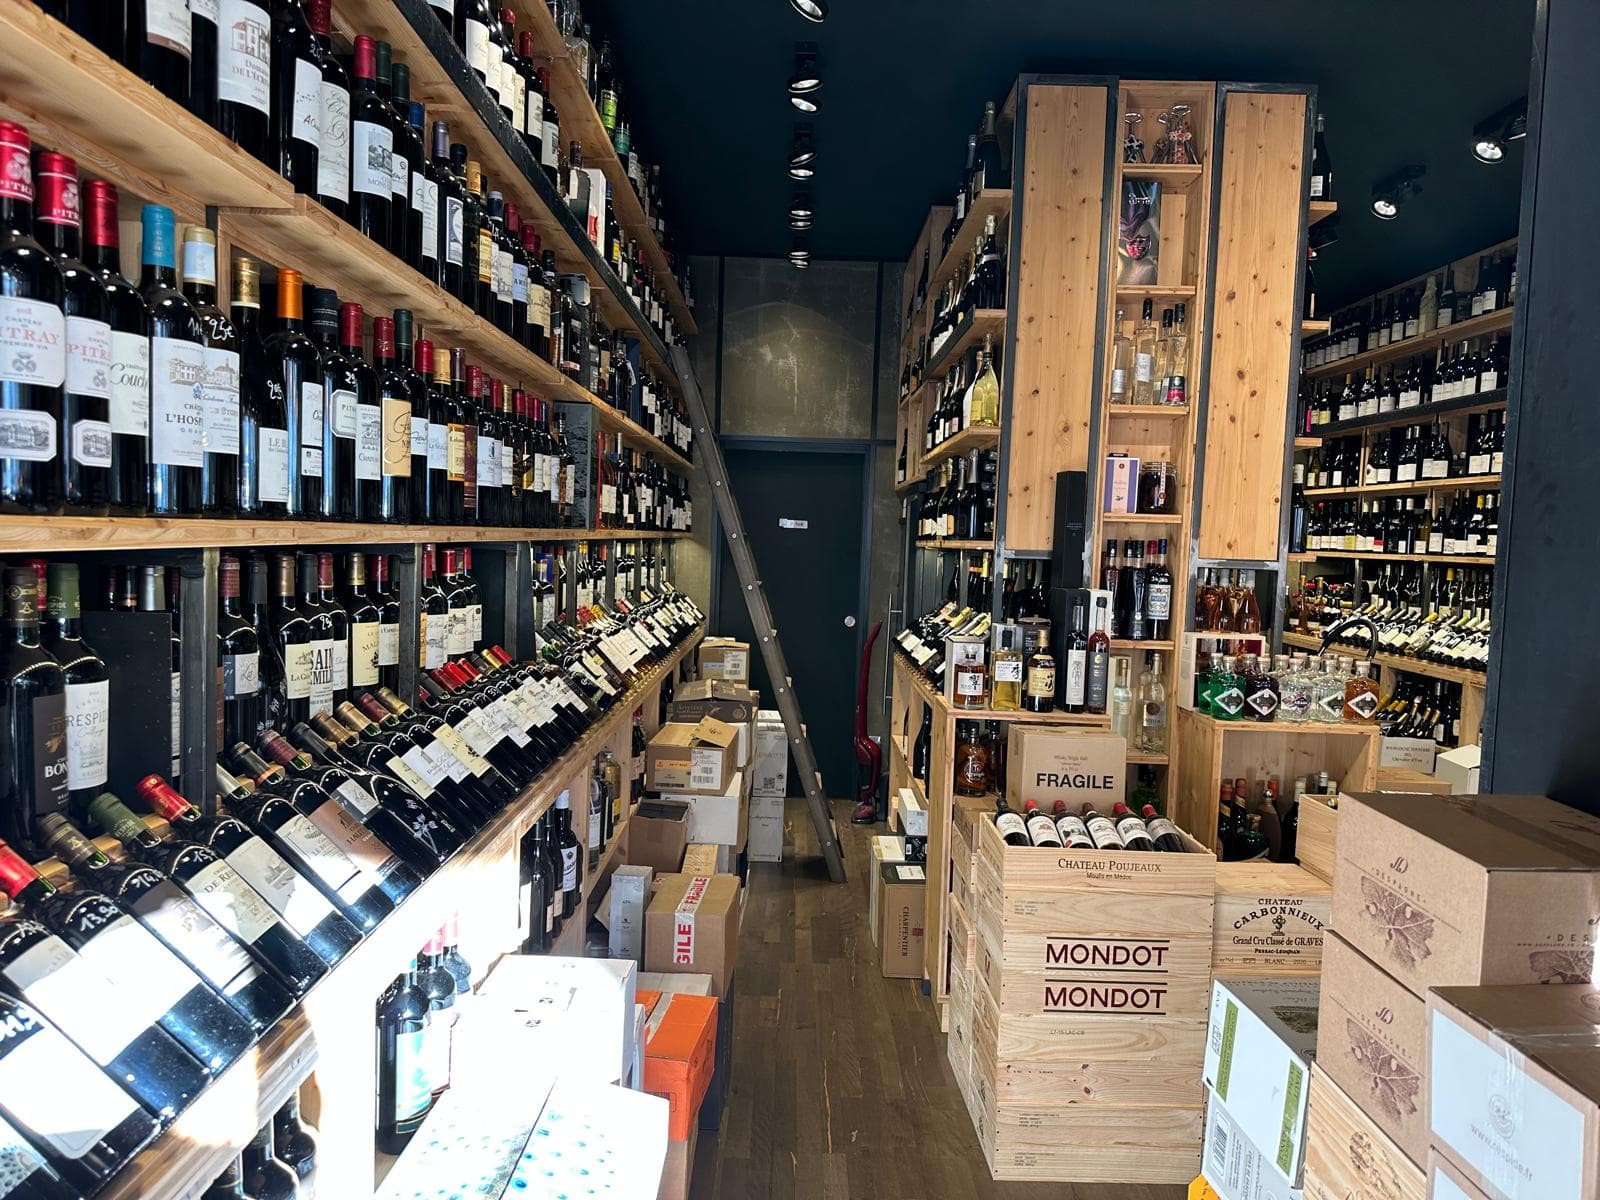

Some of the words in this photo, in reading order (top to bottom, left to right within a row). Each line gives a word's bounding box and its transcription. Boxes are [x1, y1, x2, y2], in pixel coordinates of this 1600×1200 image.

[1036, 773, 1114, 790] FRAGILE
[1058, 858, 1105, 871] CHATEAU
[1108, 860, 1162, 873] POUJEAUX
[1258, 898, 1303, 906] CHATEAU
[1233, 906, 1325, 931] CARBONNIEUX
[1232, 935, 1252, 945] Grand
[1252, 936, 1265, 945] Cru
[1265, 936, 1285, 946] Classé
[1285, 937, 1294, 946] de
[1294, 938, 1324, 946] GRAVES
[1046, 943, 1169, 966] MONDOT
[1044, 986, 1168, 1009] MONDOT
